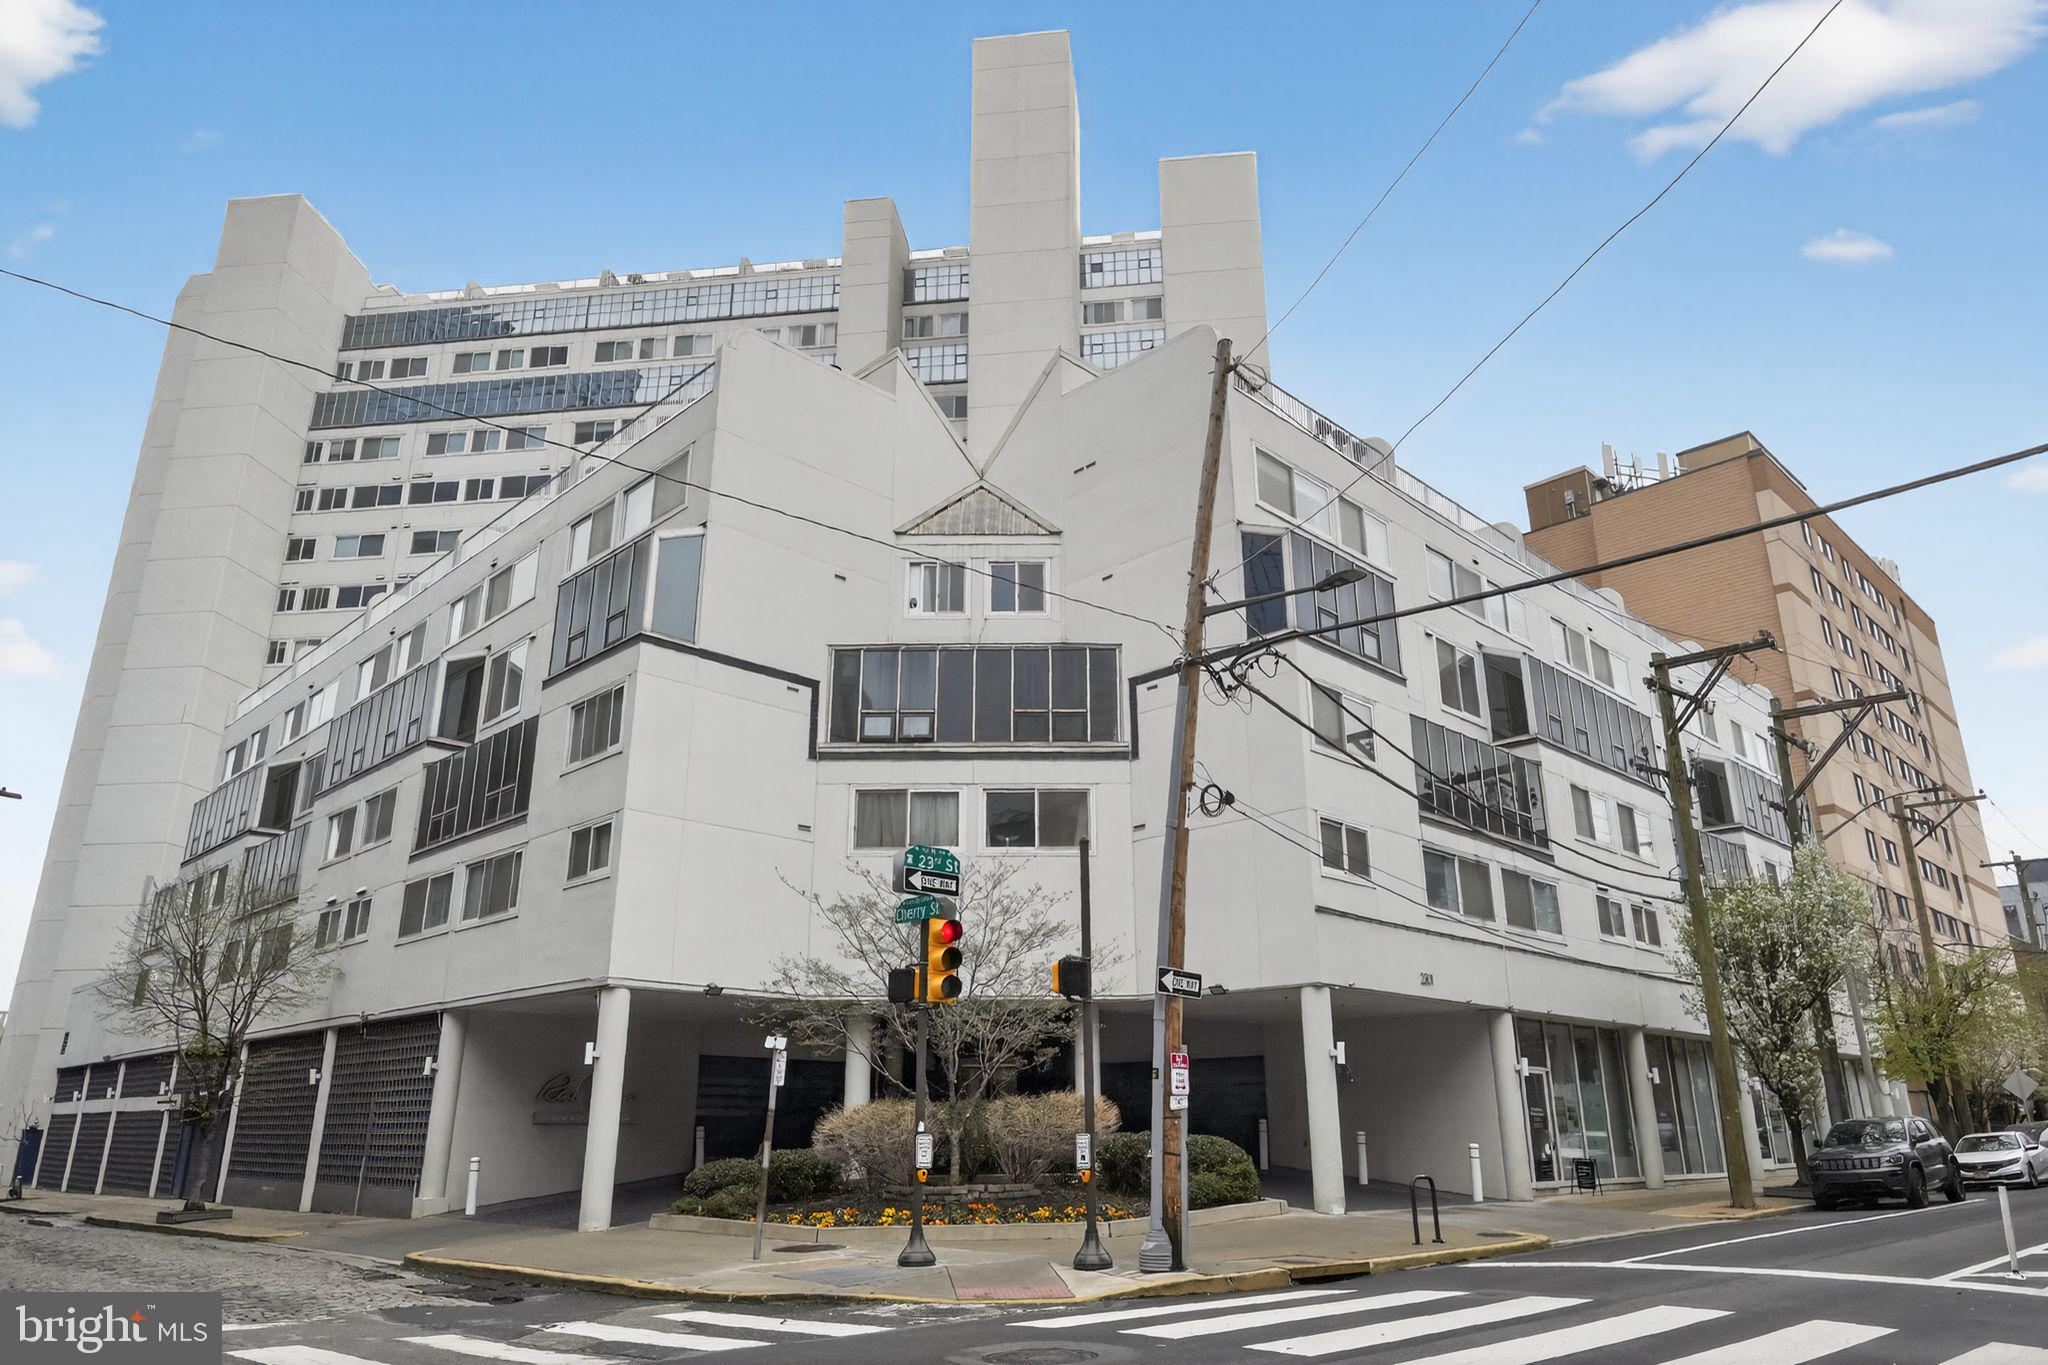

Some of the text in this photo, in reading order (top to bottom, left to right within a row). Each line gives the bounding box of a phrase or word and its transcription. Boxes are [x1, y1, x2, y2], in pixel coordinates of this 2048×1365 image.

[946, 859, 959, 873] St
[896, 901, 939, 921] Cherry St
